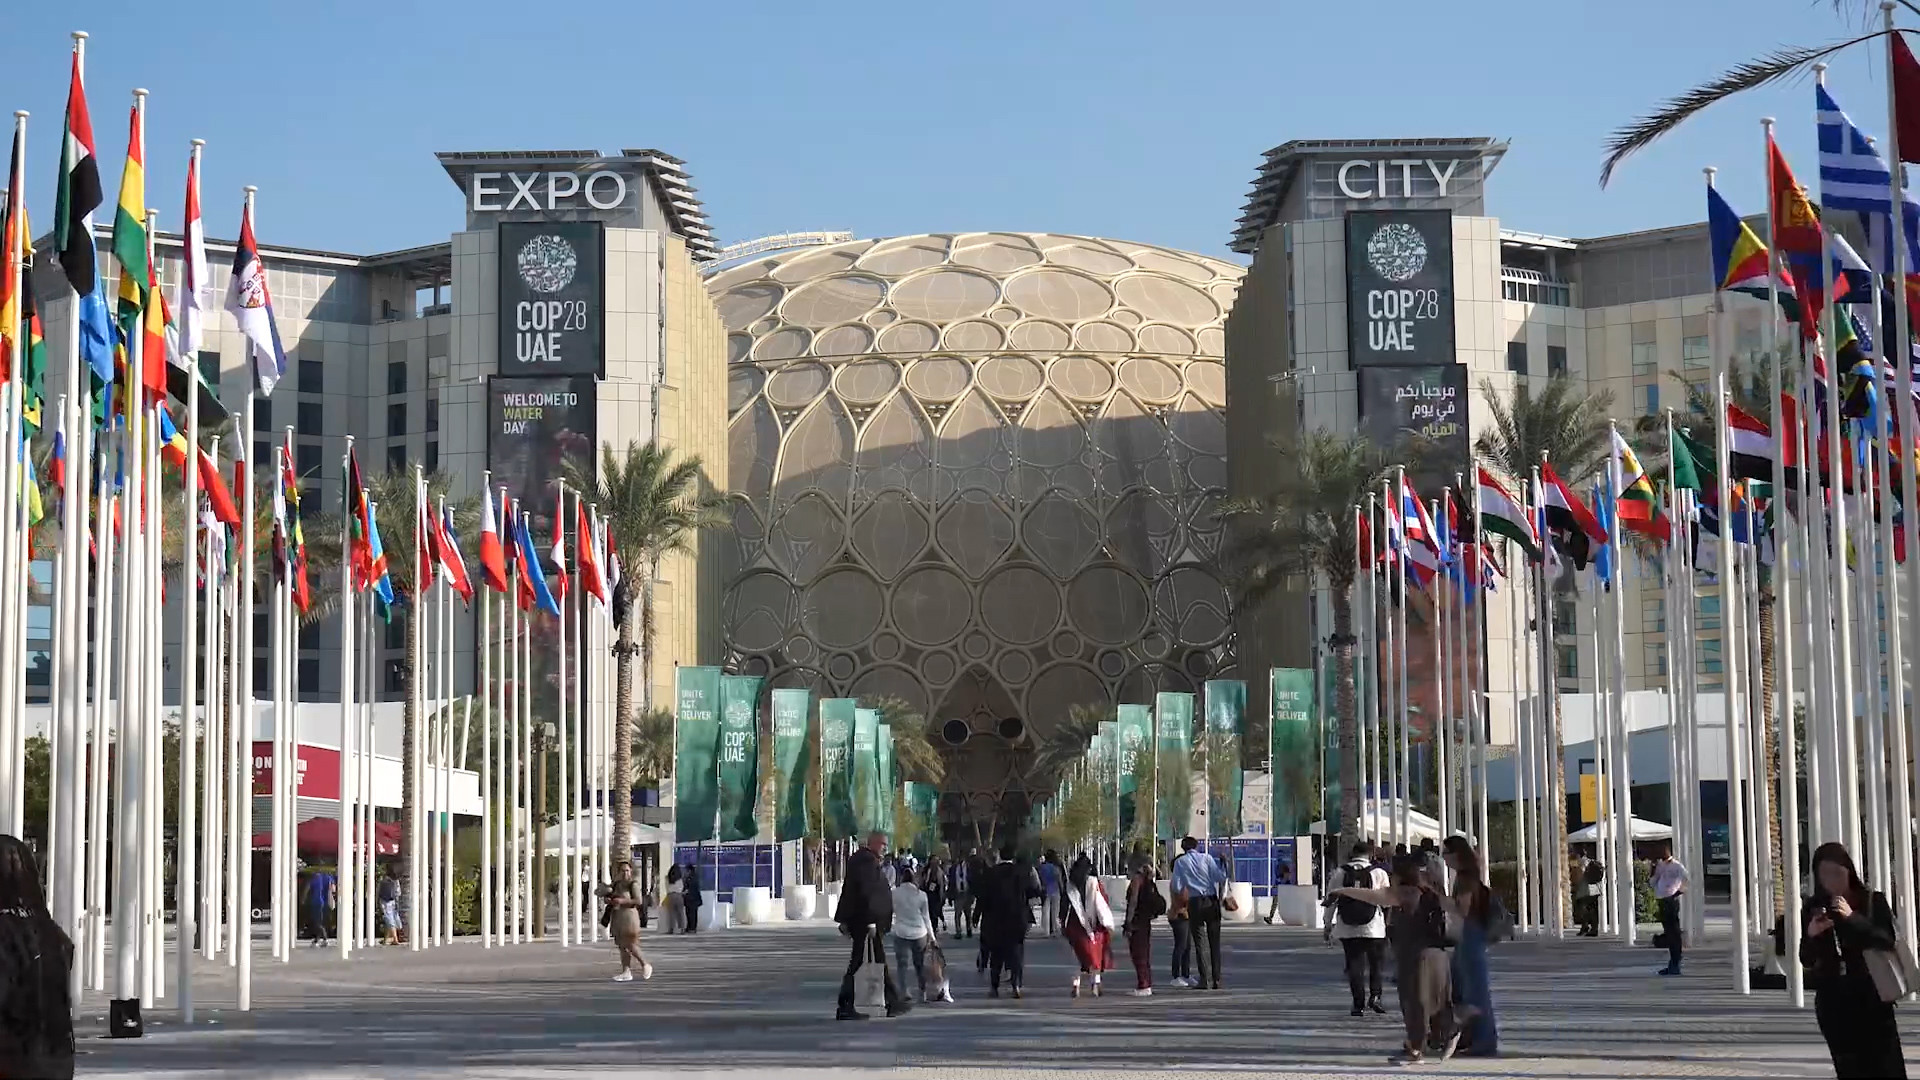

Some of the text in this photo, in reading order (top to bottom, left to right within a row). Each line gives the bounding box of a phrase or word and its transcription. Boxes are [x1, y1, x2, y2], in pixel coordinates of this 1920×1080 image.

[473, 170, 626, 211] EXPO
[1338, 159, 1460, 198] CITY
[516, 300, 587, 331] COP28
[1368, 289, 1439, 320] COP28
[516, 332, 562, 362] UAE
[1368, 320, 1415, 351] UAE
[503, 392, 578, 407] WELCOME TO
[1396, 384, 1419, 403] بكم
[503, 408, 543, 420] WATER
[1412, 401, 1455, 422] في يوم
[503, 421, 526, 434] DAY
[724, 747, 745, 762] UAE
